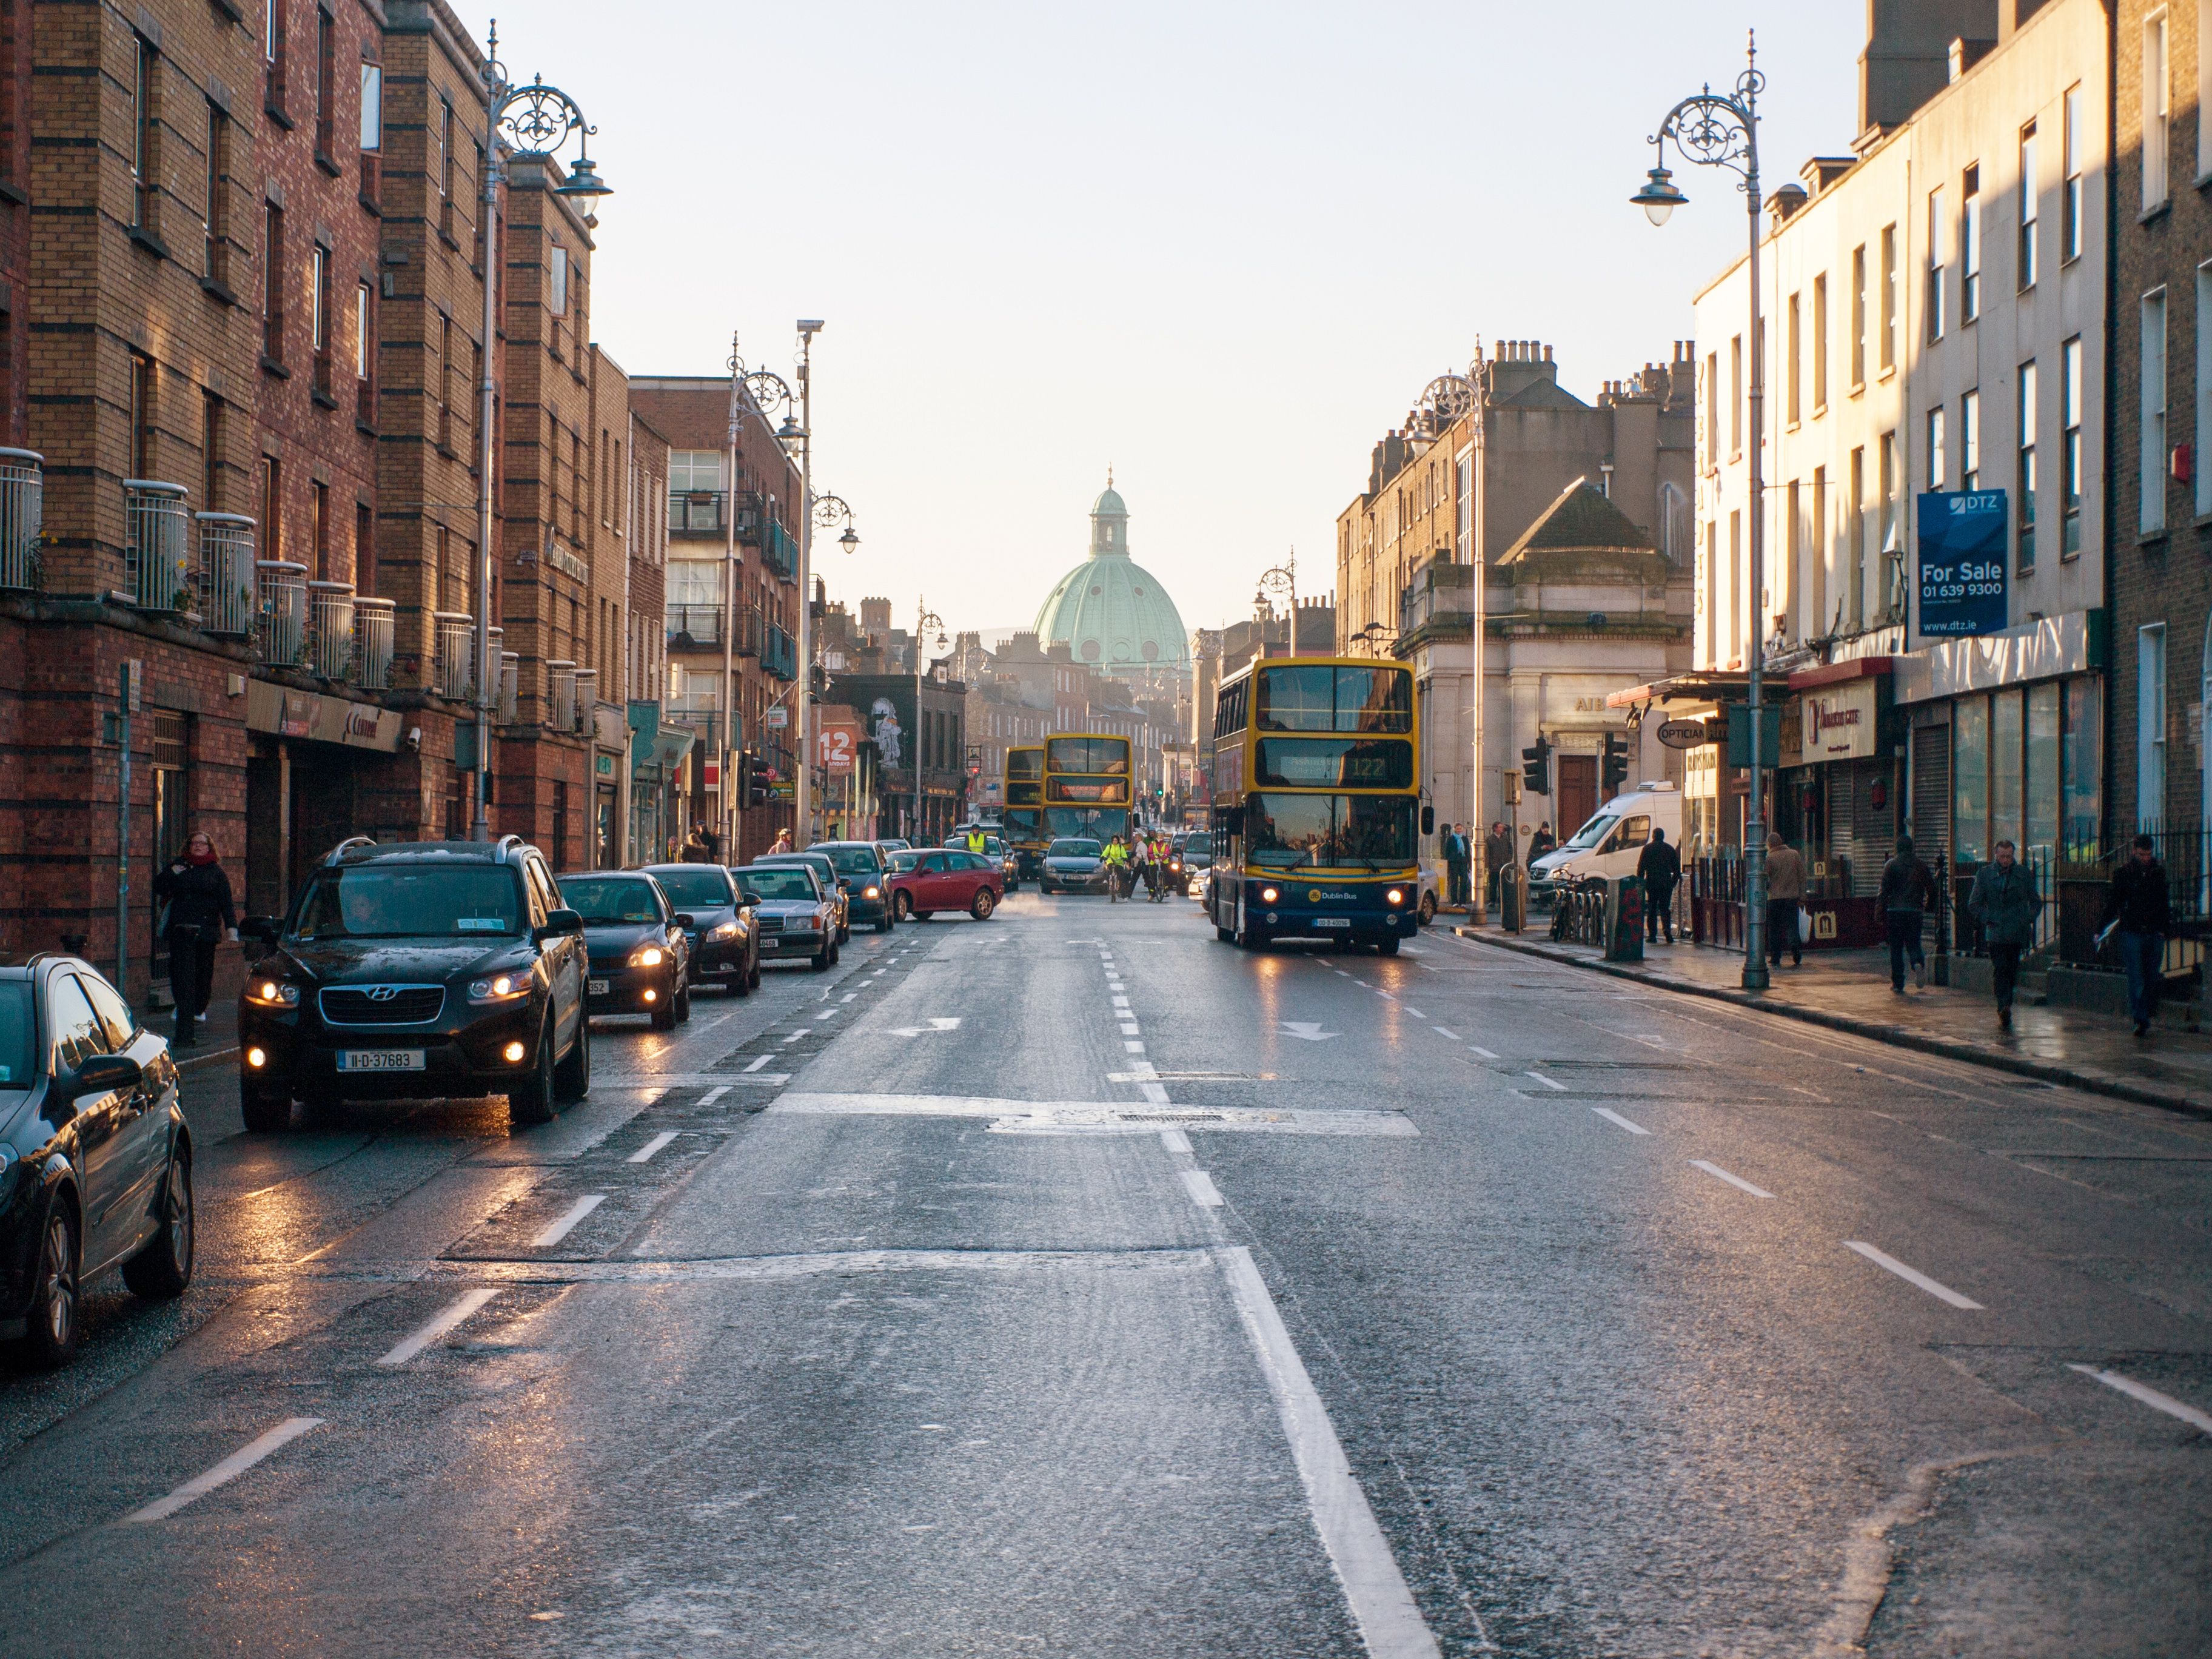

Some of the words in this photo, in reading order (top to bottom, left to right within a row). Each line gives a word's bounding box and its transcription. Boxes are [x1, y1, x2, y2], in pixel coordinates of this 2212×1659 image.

[1967, 495, 1997, 509] DTZ
[1922, 564, 1953, 582] For
[1960, 561, 2002, 580] Sale
[1923, 586, 1936, 597] 01
[1940, 585, 1965, 597] 639
[1968, 583, 2002, 595] 9300
[1923, 620, 1977, 631] www.dtz.ie
[1575, 697, 1605, 711] AIB
[819, 731, 850, 761] 12
[1353, 758, 1386, 776] 122
[352, 1054, 411, 1067] 11-D-37683
